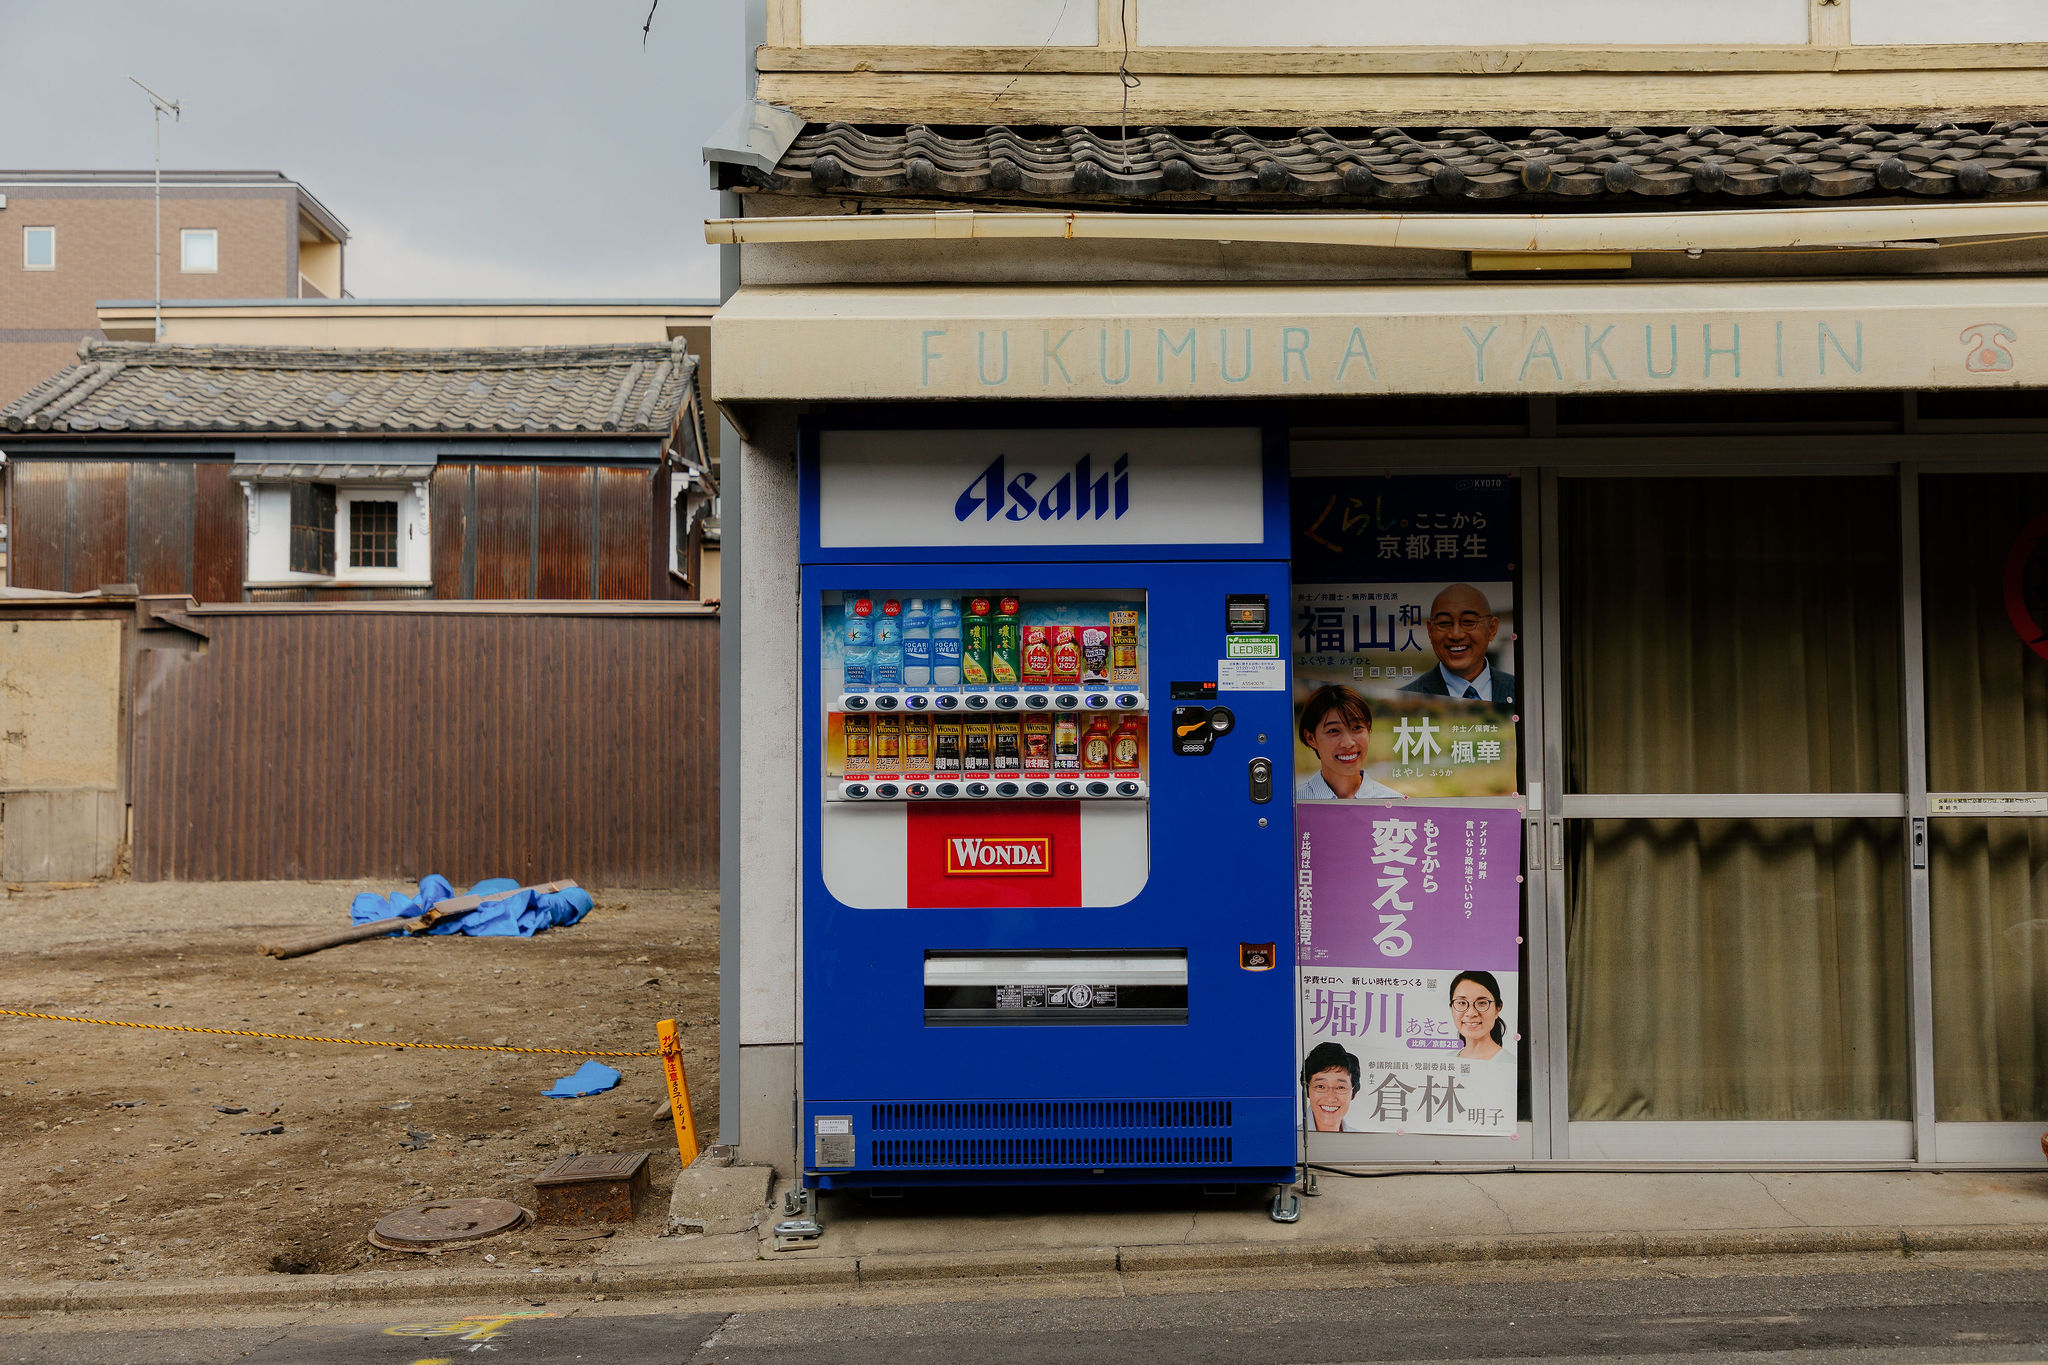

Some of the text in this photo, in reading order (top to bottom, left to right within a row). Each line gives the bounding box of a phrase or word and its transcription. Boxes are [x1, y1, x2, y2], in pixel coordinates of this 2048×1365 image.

[921, 320, 1863, 386] FUKUMURA YAKUHIN
[954, 452, 1129, 522] Asahi
[1474, 478, 1502, 488] KYOTO
[1415, 511, 1488, 530] ここから
[1376, 533, 1489, 560] 京都再生
[1297, 605, 1396, 654] 福山
[1233, 645, 1272, 655] LED照明
[1298, 655, 1336, 666] ふくやま
[846, 725, 869, 733] WONDA
[876, 725, 899, 733] WONDA
[906, 725, 928, 733] WONDA
[995, 724, 1017, 732] WONDA
[1392, 716, 1442, 765] 林
[1451, 739, 1501, 764] 楓華
[1392, 767, 1453, 778] はやし ふうか
[952, 838, 1042, 867] WONDA
[1421, 818, 1440, 894] もとから
[1370, 818, 1418, 958] 変える
[1303, 975, 1422, 987] 学費ゼロへ 新しい時代をつくる
[1309, 988, 1404, 1038] 堀川
[1405, 1017, 1449, 1036] あきこ
[1368, 1072, 1466, 1123] 倉林
[1467, 1107, 1505, 1126] 明子
